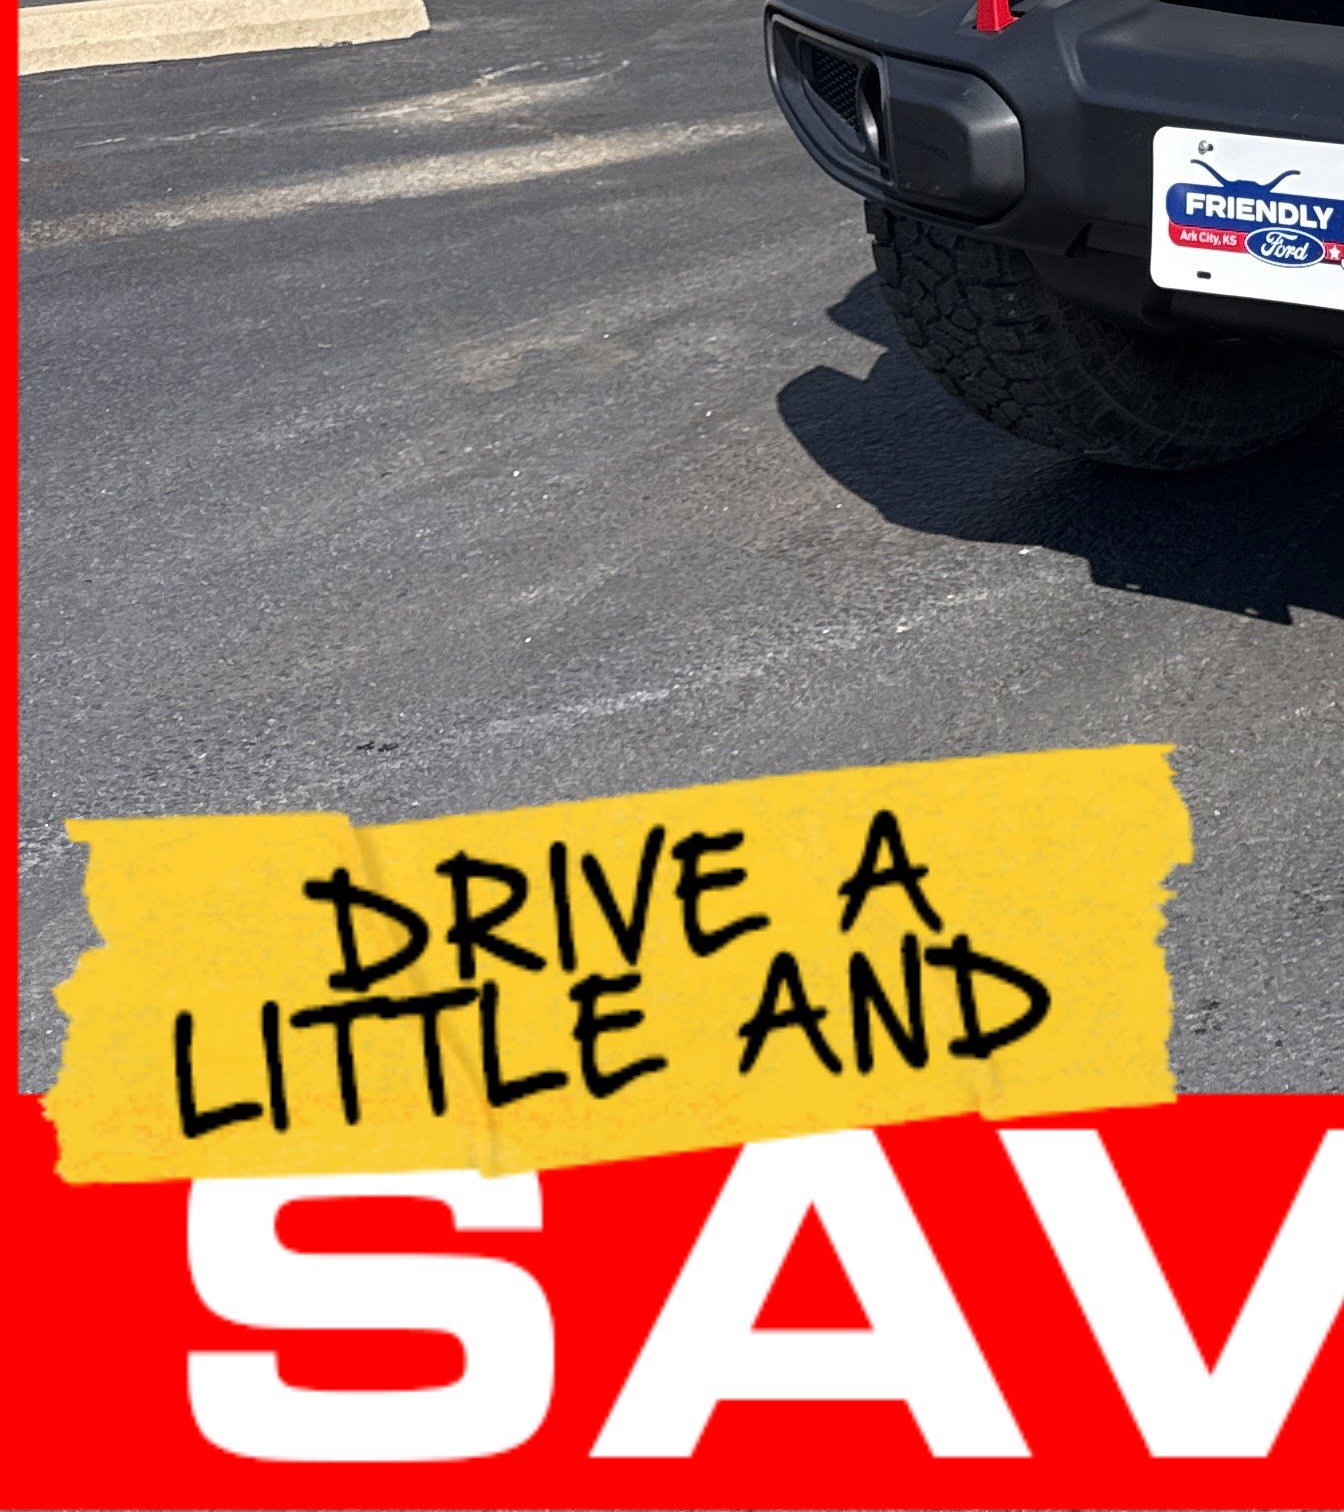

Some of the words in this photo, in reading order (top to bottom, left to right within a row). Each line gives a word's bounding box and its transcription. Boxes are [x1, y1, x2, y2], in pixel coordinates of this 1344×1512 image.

[1186, 192, 1334, 229] FRIENDLY
[1180, 229, 1197, 242] Ark
[1199, 231, 1221, 246] City,
[1223, 234, 1238, 246] KS
[1260, 231, 1309, 261] Ford
